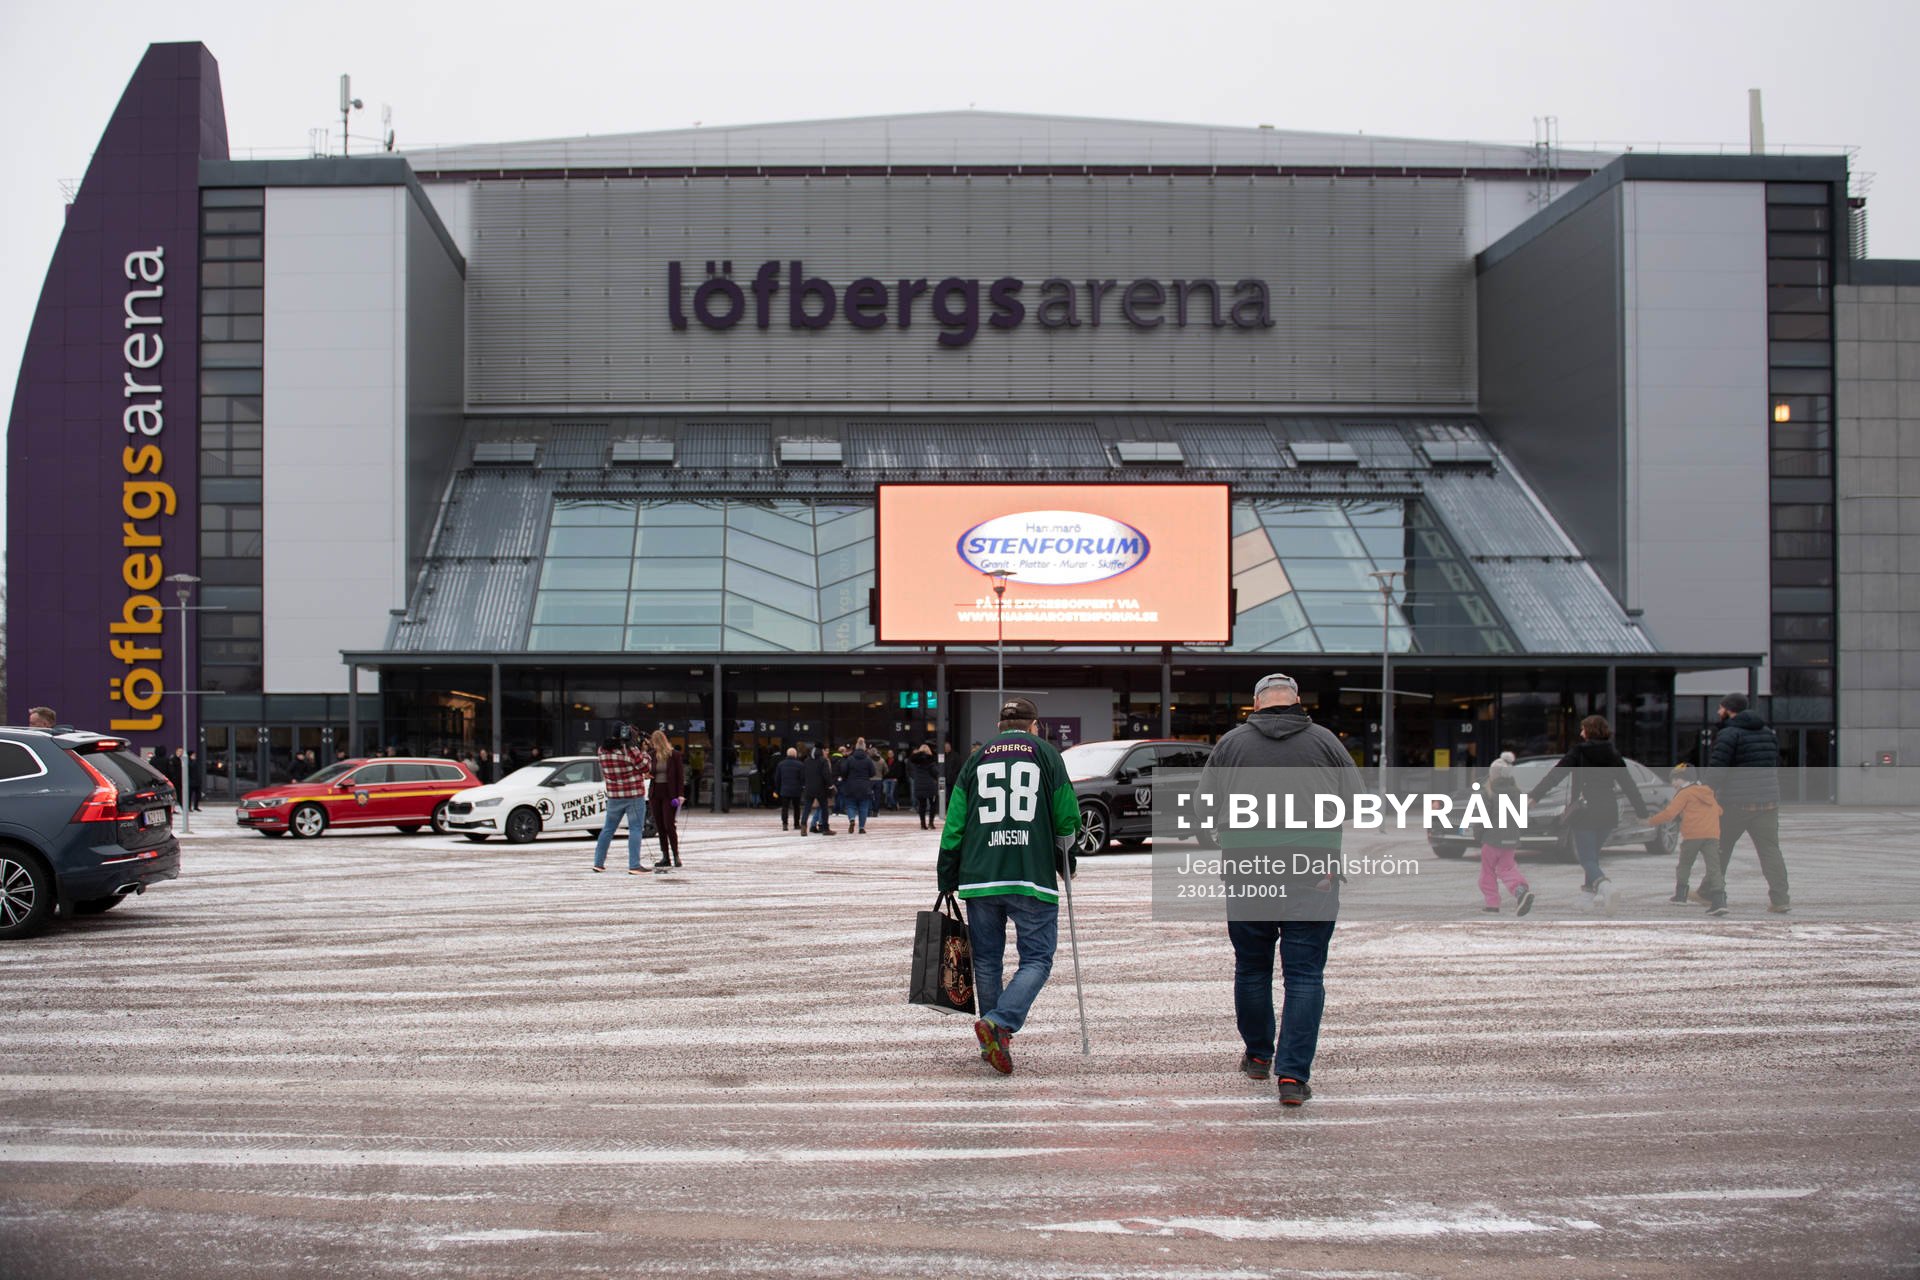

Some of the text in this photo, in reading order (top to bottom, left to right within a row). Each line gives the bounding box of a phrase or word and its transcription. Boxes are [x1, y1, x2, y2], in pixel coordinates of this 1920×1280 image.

[668, 260, 1276, 348] löfbergsarena
[110, 245, 177, 732] löfbergsarena
[967, 538, 1139, 554] STENFORUM
[1117, 598, 1140, 609] VIA
[760, 722, 767, 732] 3
[793, 722, 801, 732] 4
[984, 743, 1033, 755] LÖFBERGS
[976, 761, 1041, 825] 58
[561, 798, 582, 810] VINN
[583, 795, 594, 804] EN
[564, 804, 596, 823] FRÅN
[988, 829, 1030, 847] JANSSON
